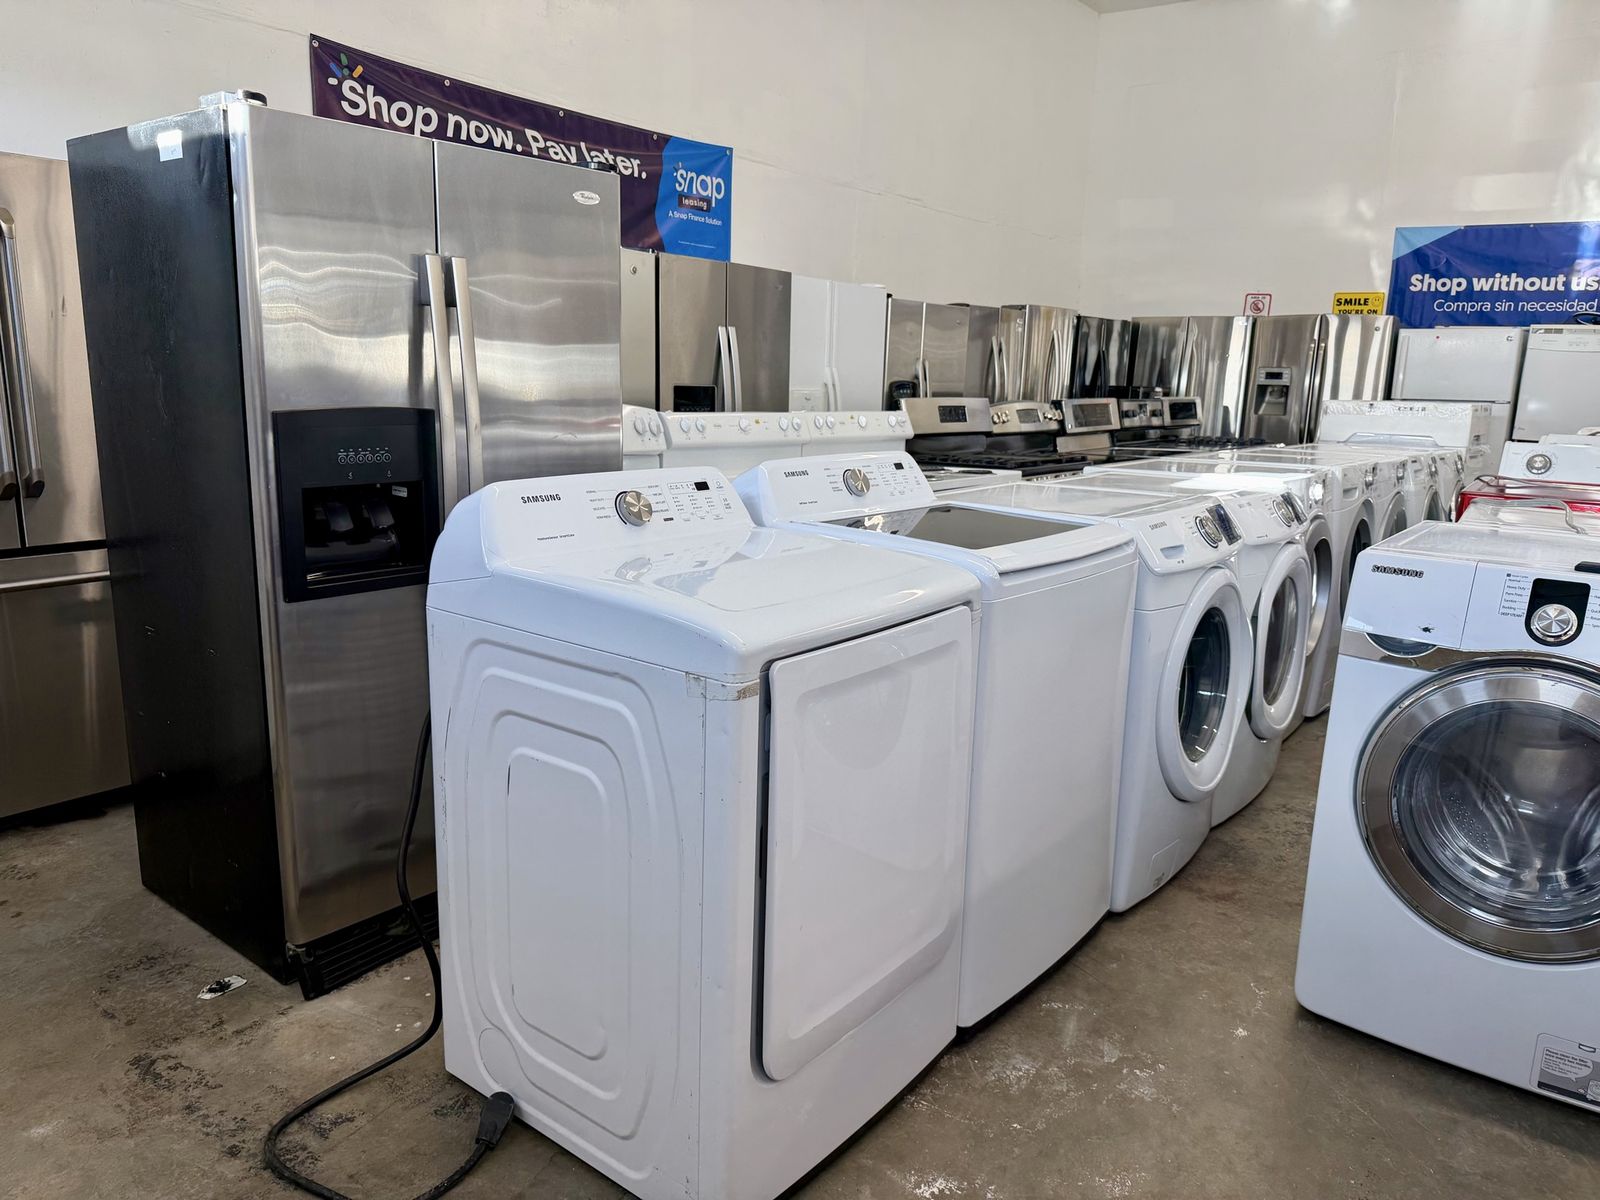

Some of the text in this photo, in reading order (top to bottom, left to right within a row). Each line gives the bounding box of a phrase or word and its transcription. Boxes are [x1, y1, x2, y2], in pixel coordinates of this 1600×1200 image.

[341, 80, 439, 137] Shop
[446, 112, 523, 152] now.
[524, 127, 577, 164] Pay
[675, 168, 725, 208] snap
[682, 196, 708, 211] leasing
[668, 210, 674, 218] A
[1409, 273, 1468, 296] Shop
[1472, 272, 1566, 292] without
[1335, 298, 1370, 306] SMILE
[1433, 298, 1598, 315] Compra sin necesidad
[783, 469, 809, 478] SAMSUNG
[520, 493, 562, 505] SAMSUNG
[1371, 564, 1425, 579] SAMSUNG
